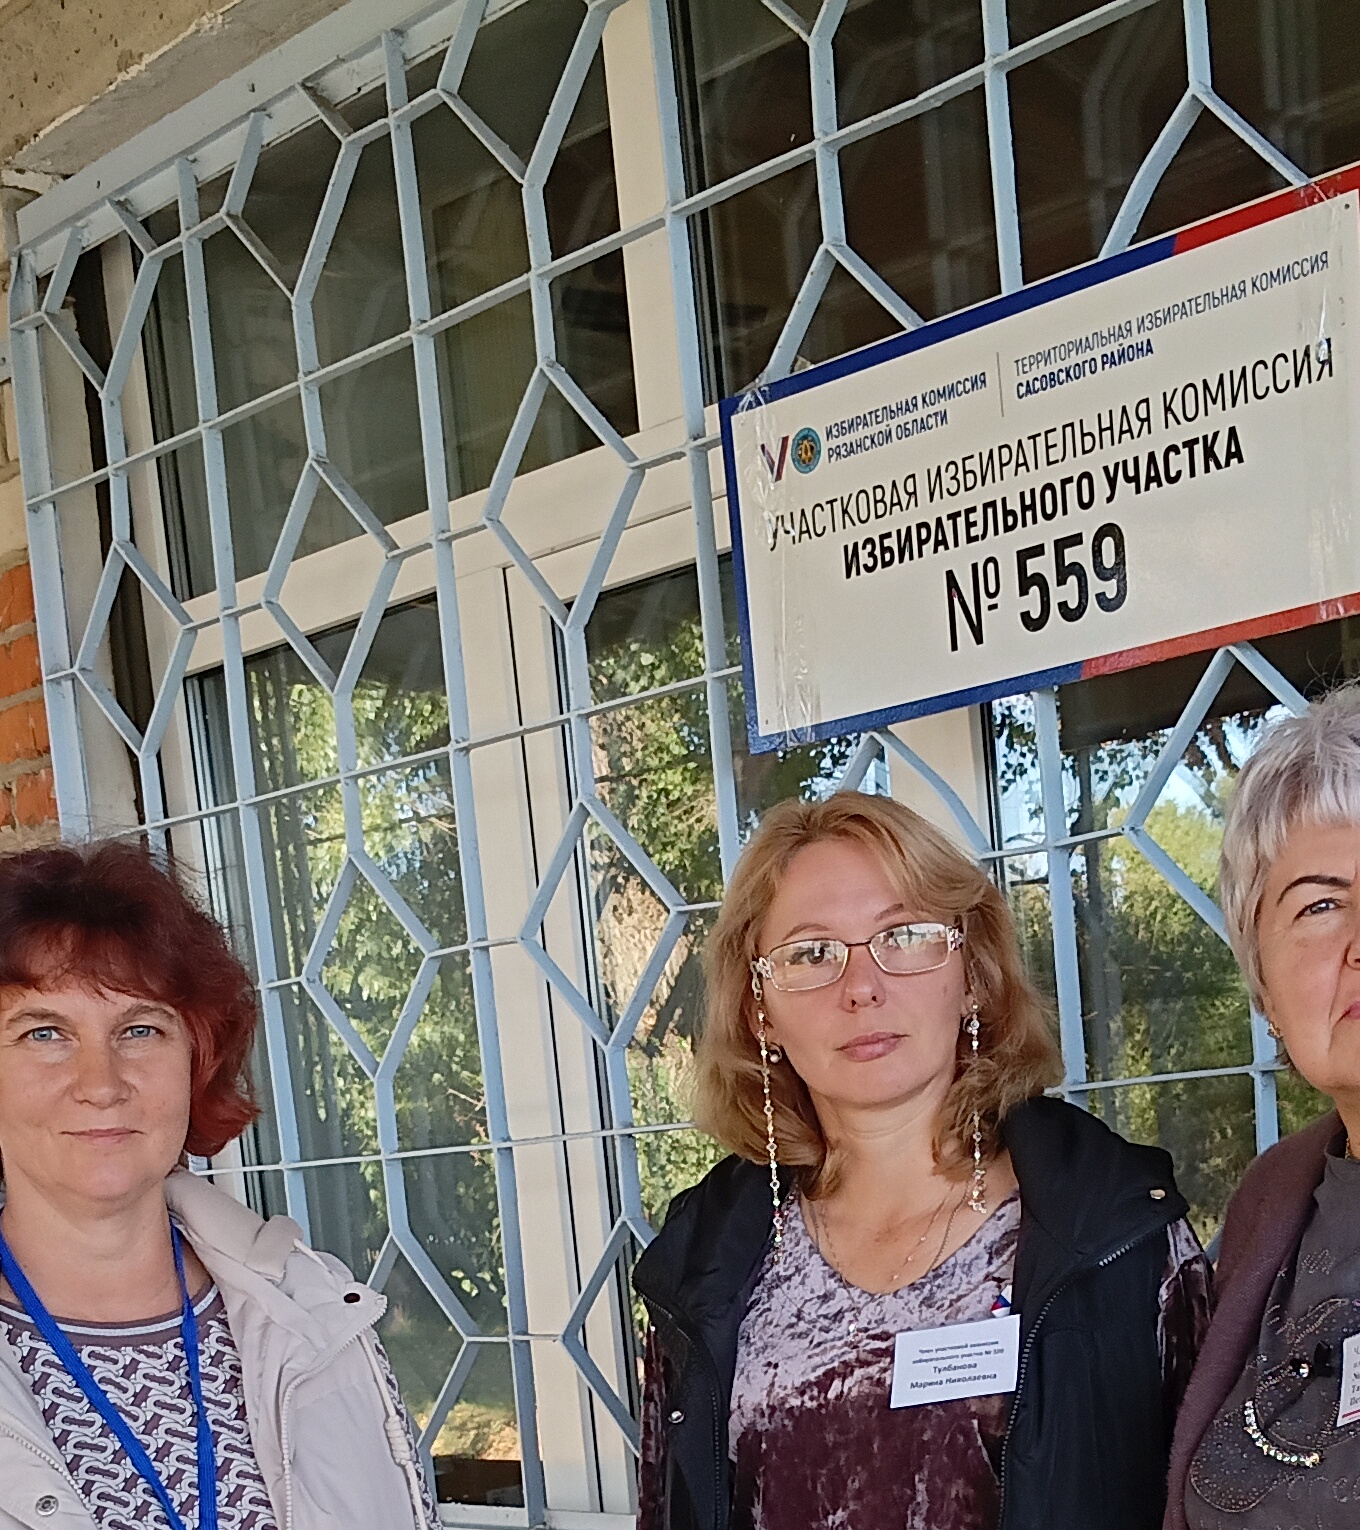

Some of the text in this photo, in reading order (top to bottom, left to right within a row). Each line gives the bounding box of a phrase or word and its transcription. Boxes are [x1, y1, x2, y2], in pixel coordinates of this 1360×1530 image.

[1014, 250, 1329, 377] ТЕРРИТОРИАЛЬНАЯ ИЗБИРАТЕЛЬНАЯ КОМИССИЯ
[1016, 338, 1154, 400] САСОВСКОГО РАЙОНА
[767, 338, 1335, 552] УЧАСТКОВАЯ ИЗБИРАТЕЛЬНАЯ КОМИССИЯ
[825, 371, 987, 442] ИЗБИРАТЕЛЬНАЯ КОМИССИЯ
[827, 409, 948, 463] РЯЗАНСКОЙ ОБЛАСТИ
[842, 425, 1245, 580] ИЗБИРАТЕЛЬНОГО УЧАСТКА
[945, 521, 1129, 652] № 559
